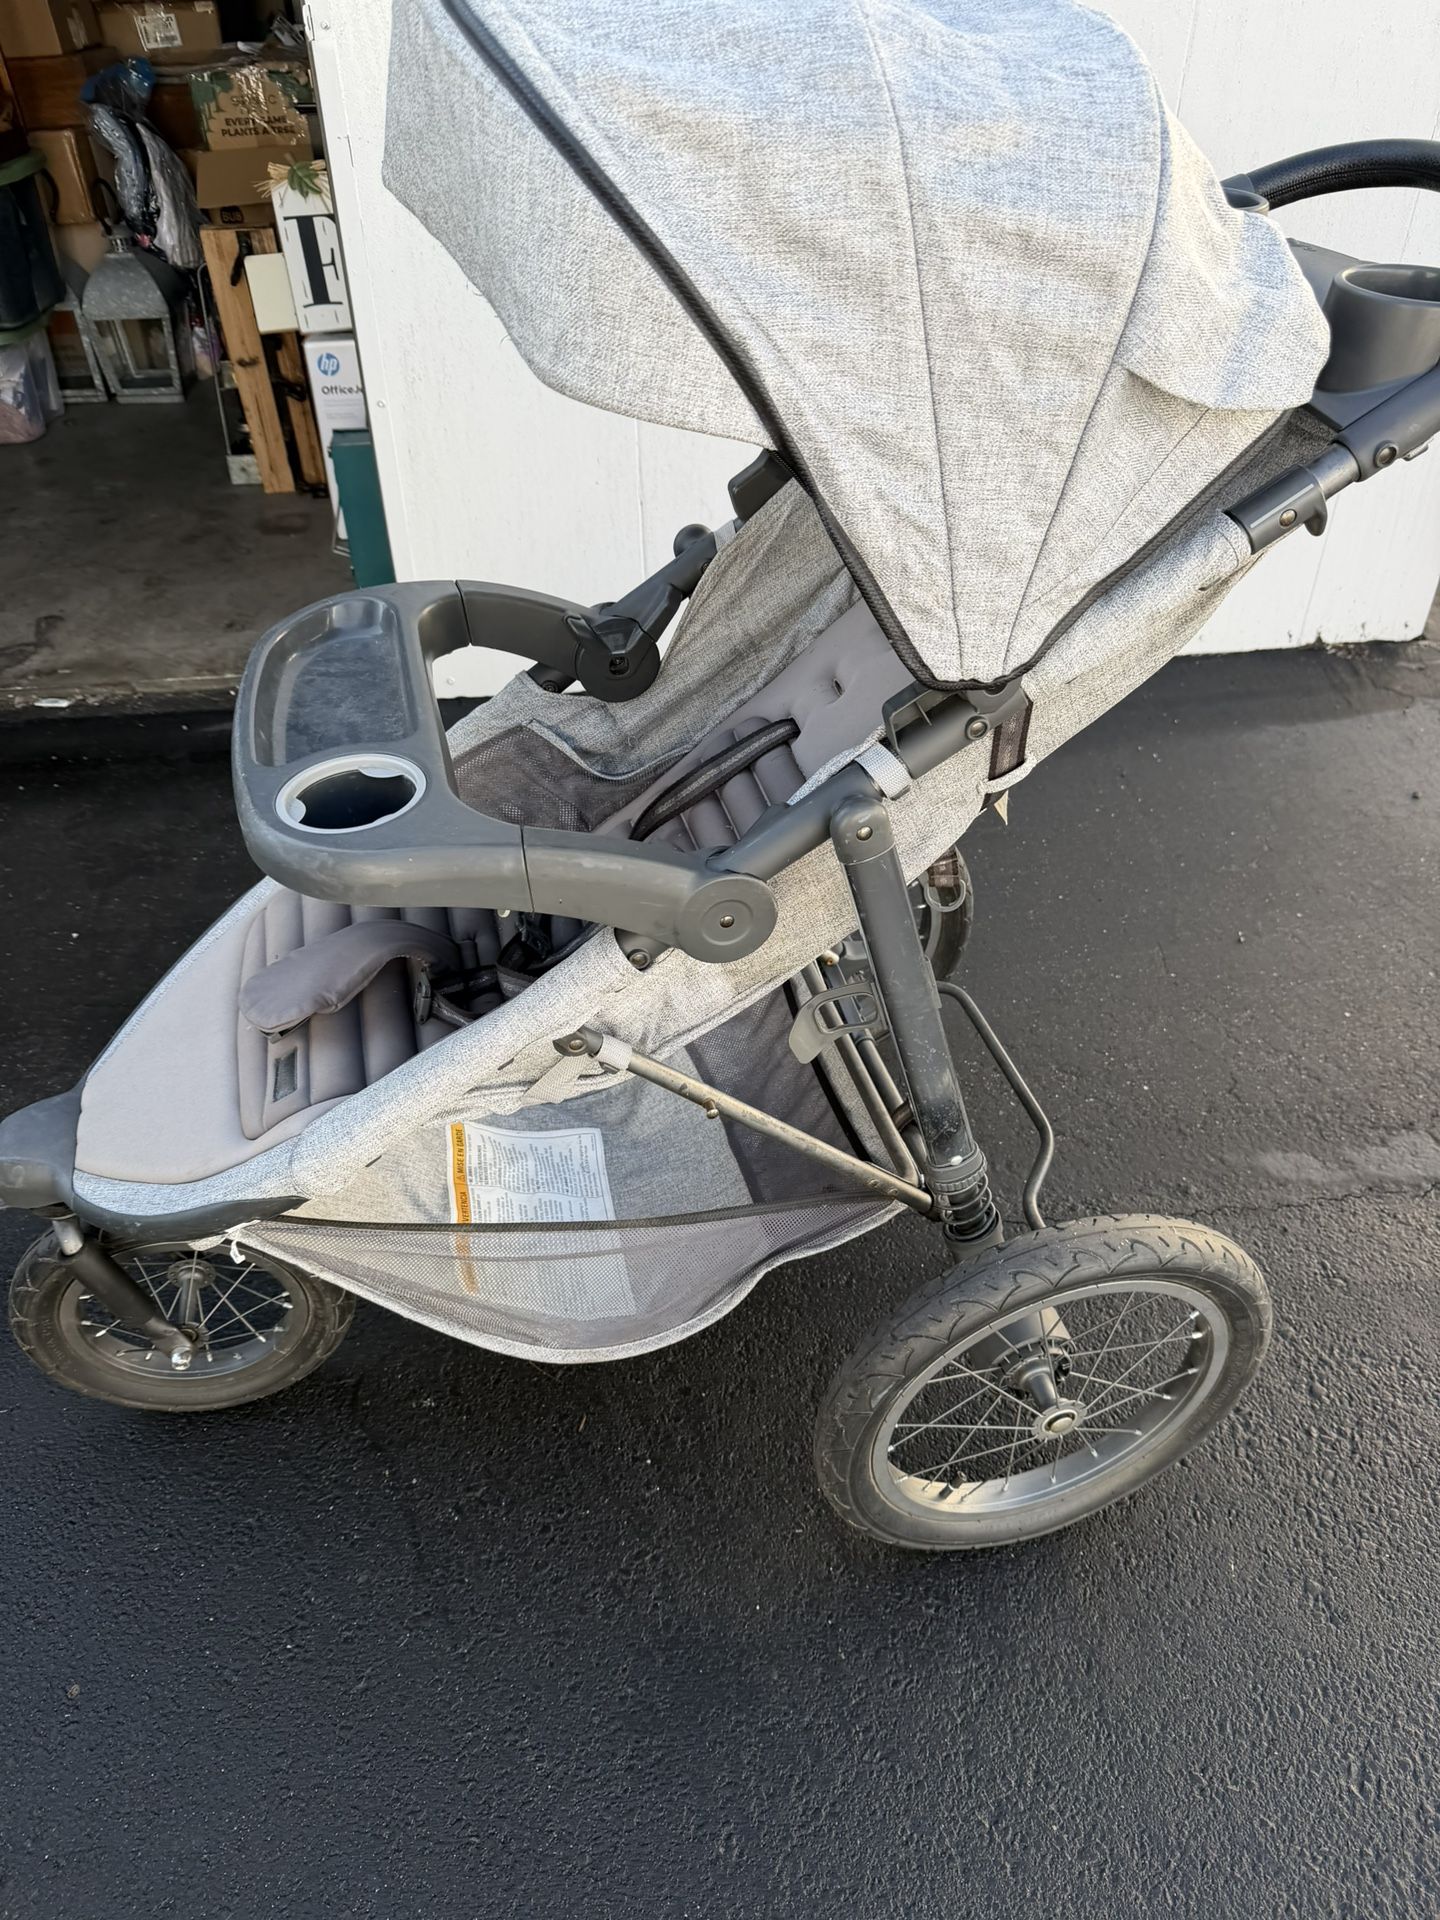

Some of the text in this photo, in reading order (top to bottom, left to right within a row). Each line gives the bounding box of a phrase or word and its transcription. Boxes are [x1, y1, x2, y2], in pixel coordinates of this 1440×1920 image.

[221, 127, 260, 136] PLANTS
[262, 127, 270, 135] A
[225, 117, 256, 127] EVERY
[283, 213, 343, 308] F
[319, 353, 338, 376] hp
[455, 1128, 465, 1174] MISE EN GARDE
[460, 1191, 470, 1222] VERTENCIA
